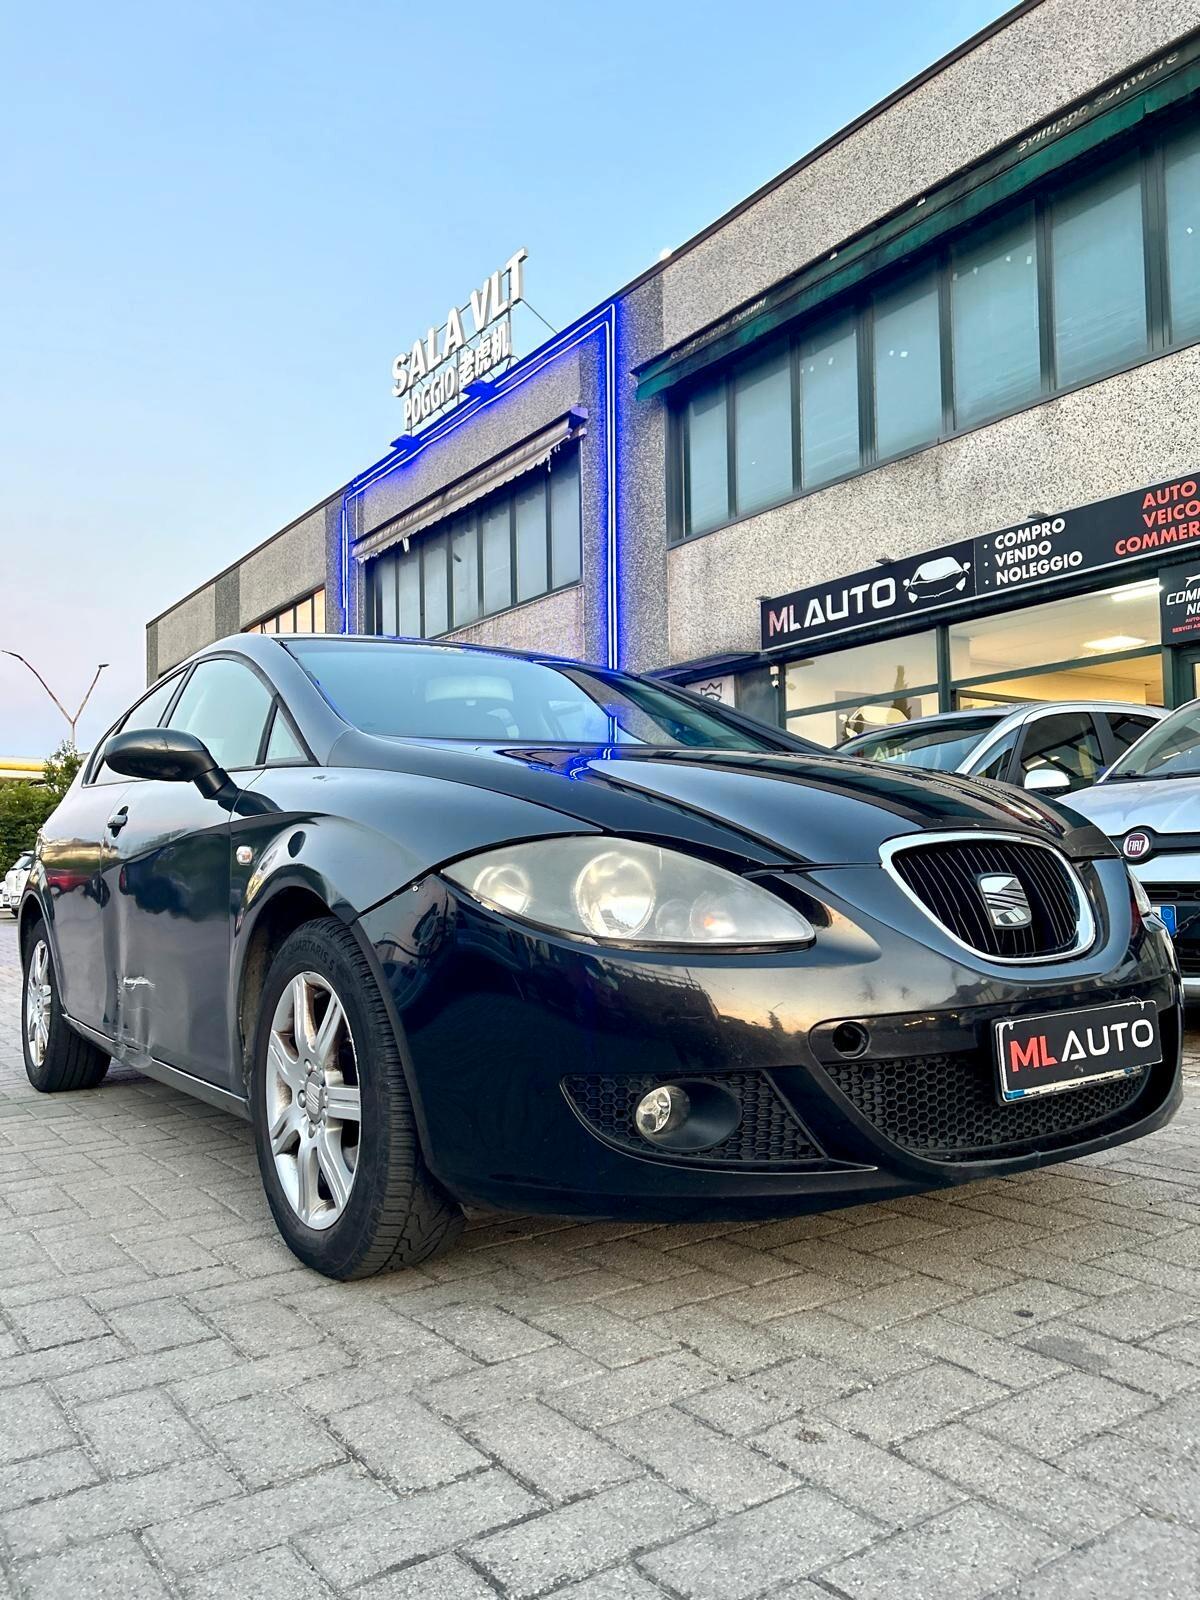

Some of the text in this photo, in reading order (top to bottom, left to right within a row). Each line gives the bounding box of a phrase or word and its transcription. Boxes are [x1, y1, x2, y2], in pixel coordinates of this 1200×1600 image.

[391, 247, 528, 397] SALA VLT
[403, 365, 459, 431] POGGIO
[1142, 480, 1197, 510] AUTO
[1142, 500, 1200, 528] VEICO
[994, 517, 1066, 550] COMPRO
[995, 540, 1052, 568] VENDO
[996, 550, 1083, 586] NOLEGGIO
[1128, 840, 1144, 852] FIAT
